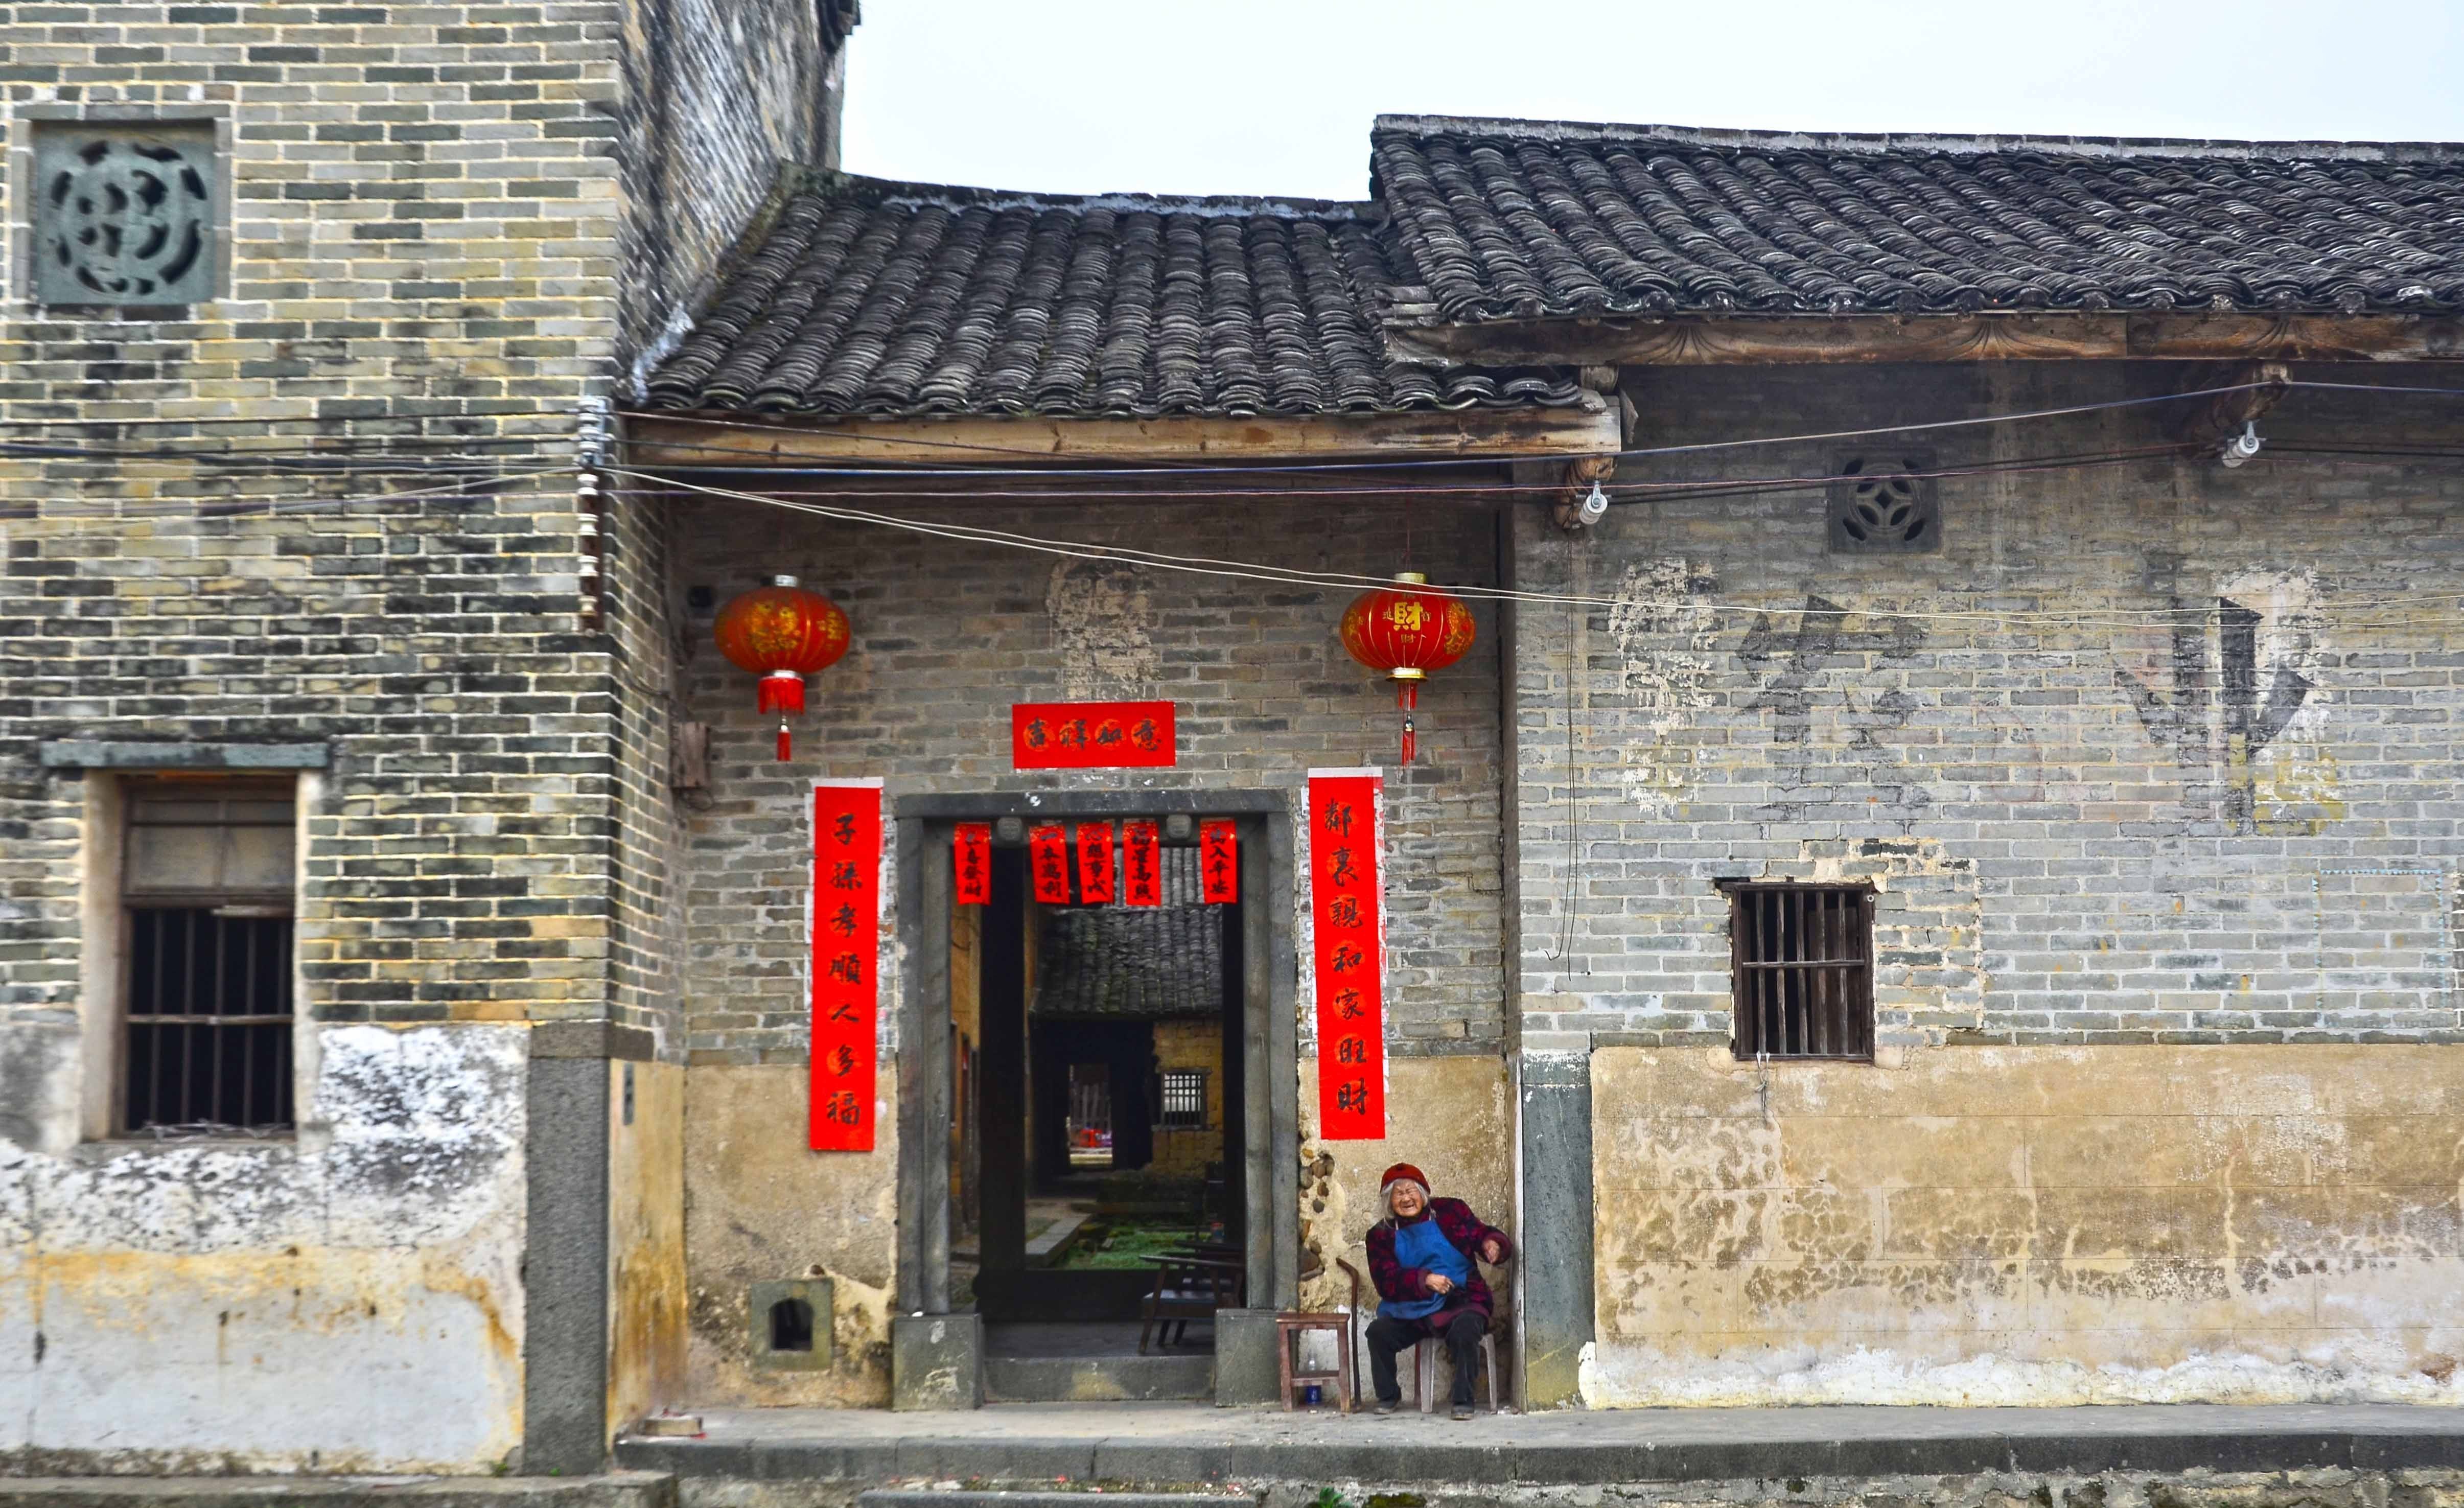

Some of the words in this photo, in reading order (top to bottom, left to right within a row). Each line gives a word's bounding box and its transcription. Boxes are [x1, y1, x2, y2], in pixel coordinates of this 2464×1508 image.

[1393, 602, 1423, 631] 財
[1027, 714, 1161, 752] 吉祥如意
[826, 814, 862, 1126] 子孫孝順人多福
